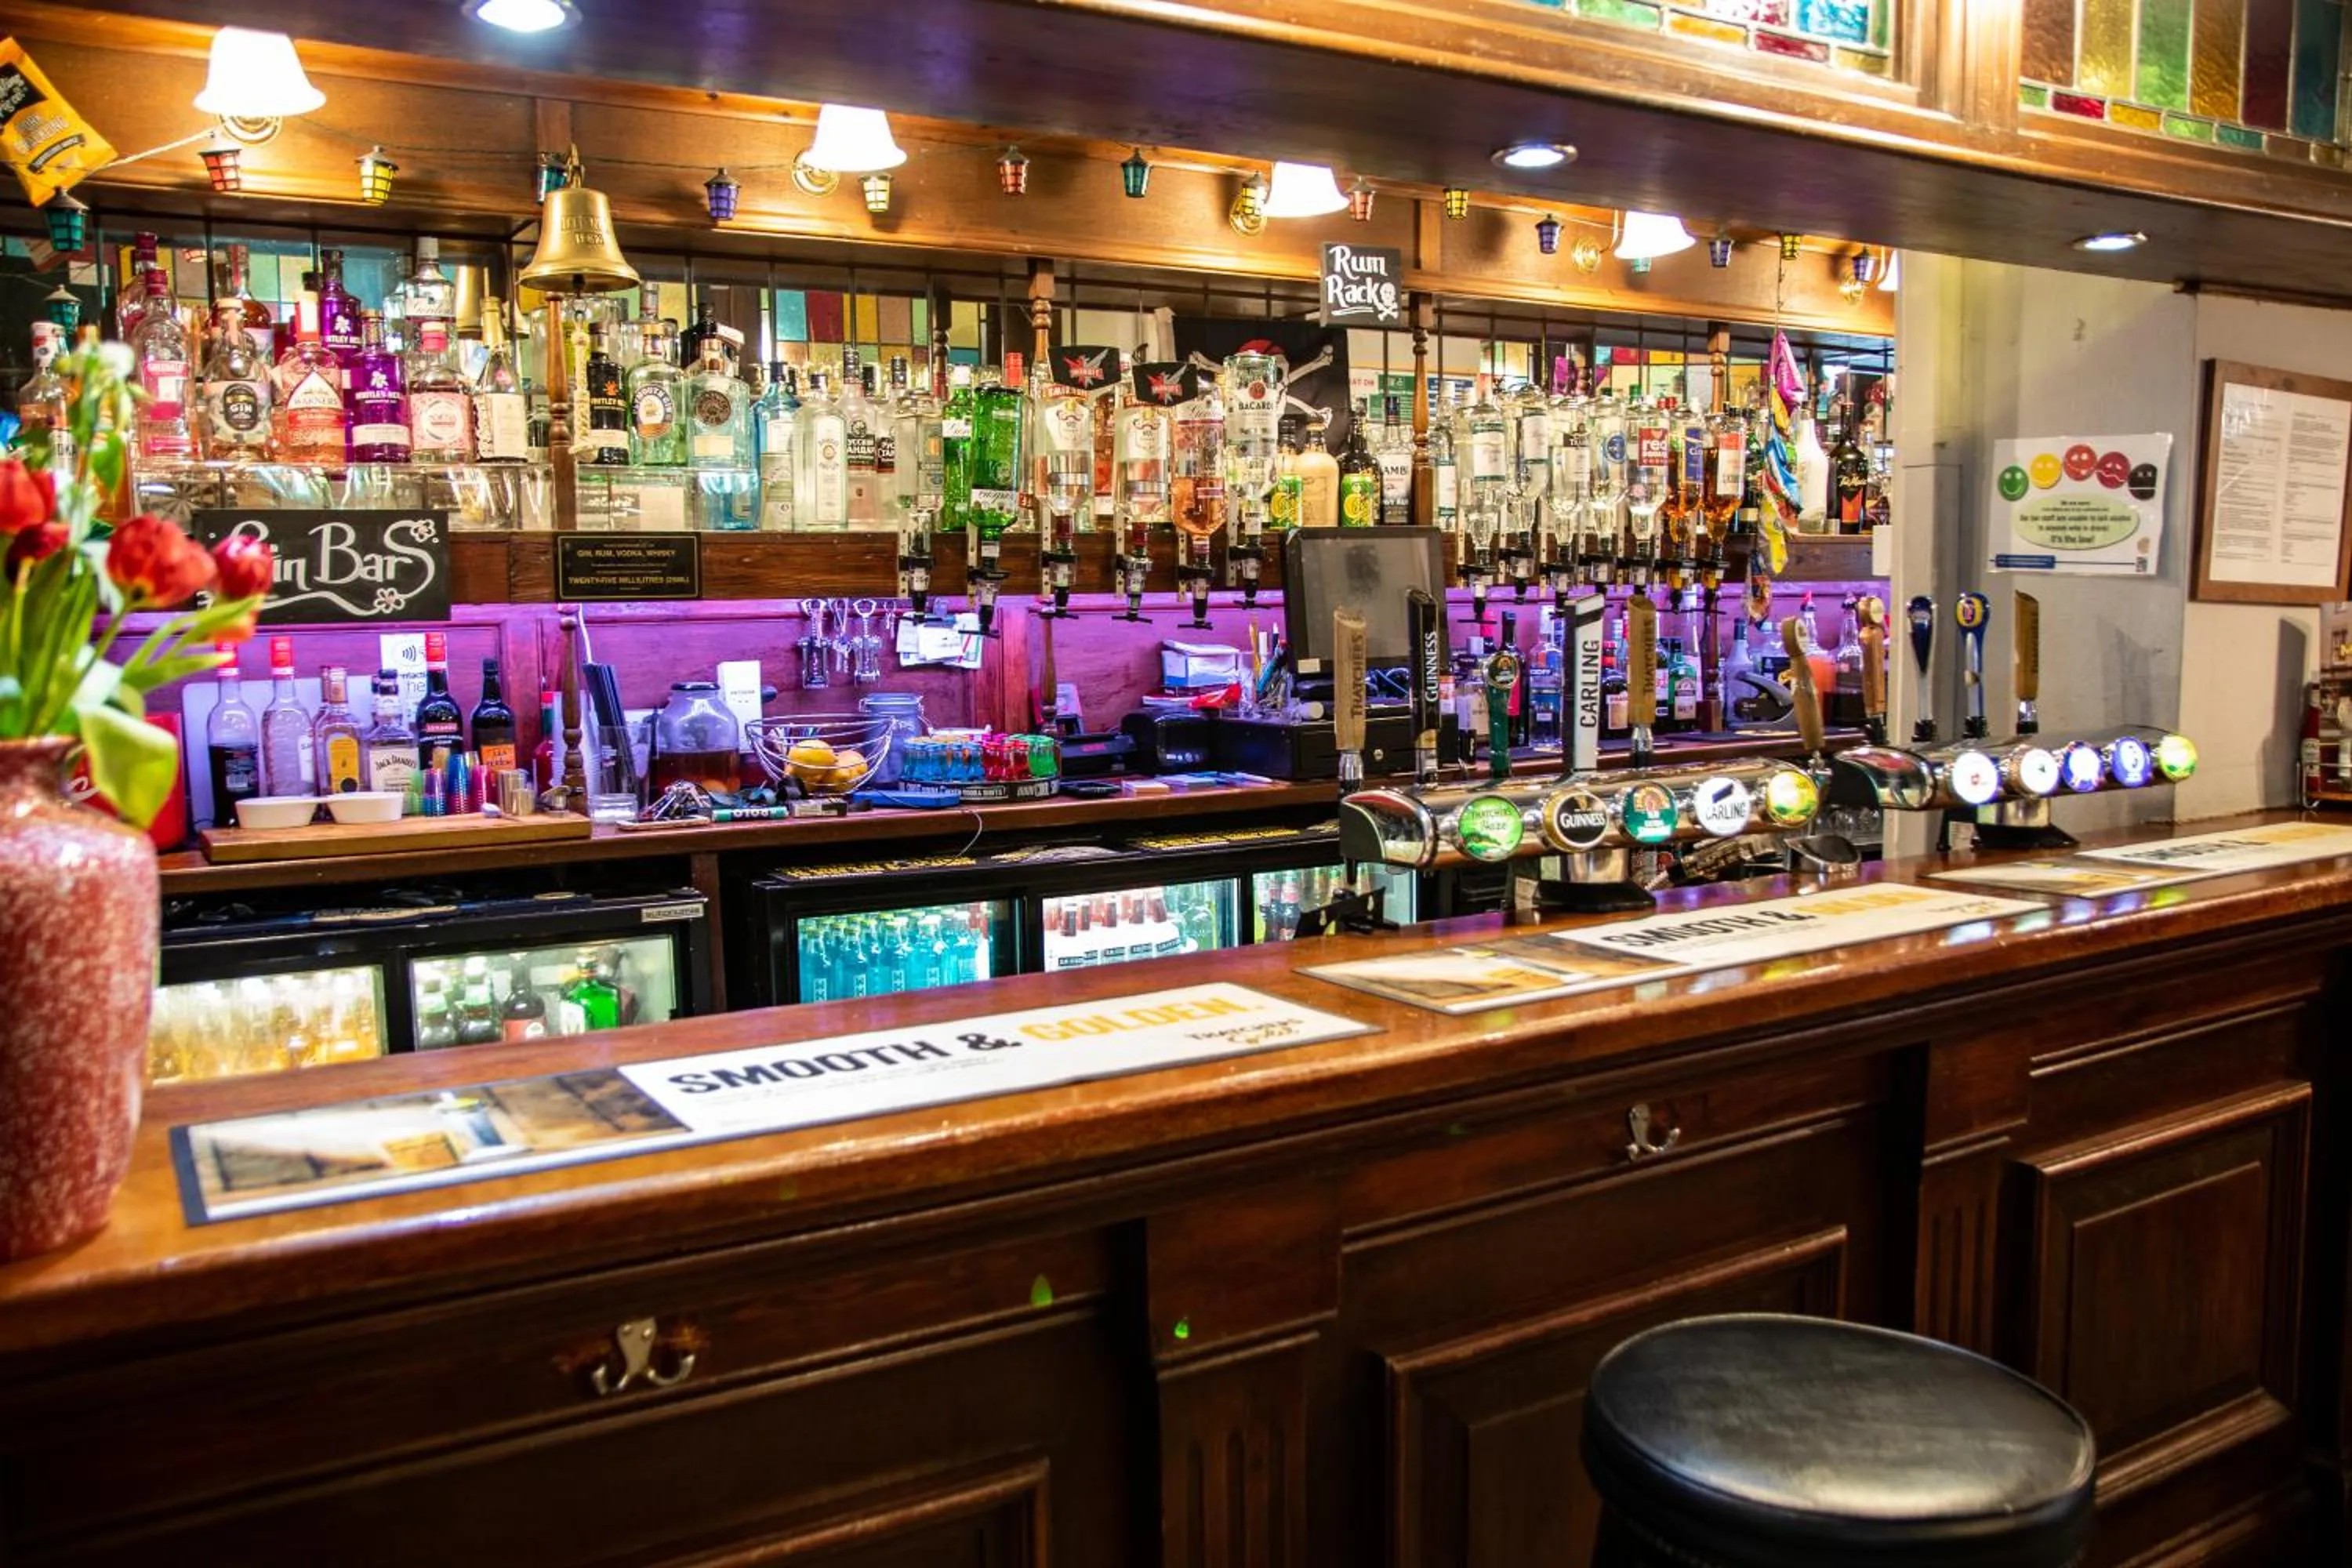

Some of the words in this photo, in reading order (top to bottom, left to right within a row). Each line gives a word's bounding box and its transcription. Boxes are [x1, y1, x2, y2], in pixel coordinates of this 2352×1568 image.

[1329, 245, 1388, 279] Rum
[1325, 274, 1380, 308] Rack
[230, 405, 252, 413] GIN
[1351, 630, 1363, 719] THATCHERS
[1425, 630, 1438, 702] GUINNESS
[1580, 639, 1600, 728] CARLING
[1559, 813, 1605, 828] GUINNESS
[1706, 803, 1747, 821] CARLING
[668, 1040, 951, 1094] SMOOTH
[956, 1033, 1022, 1052] &
